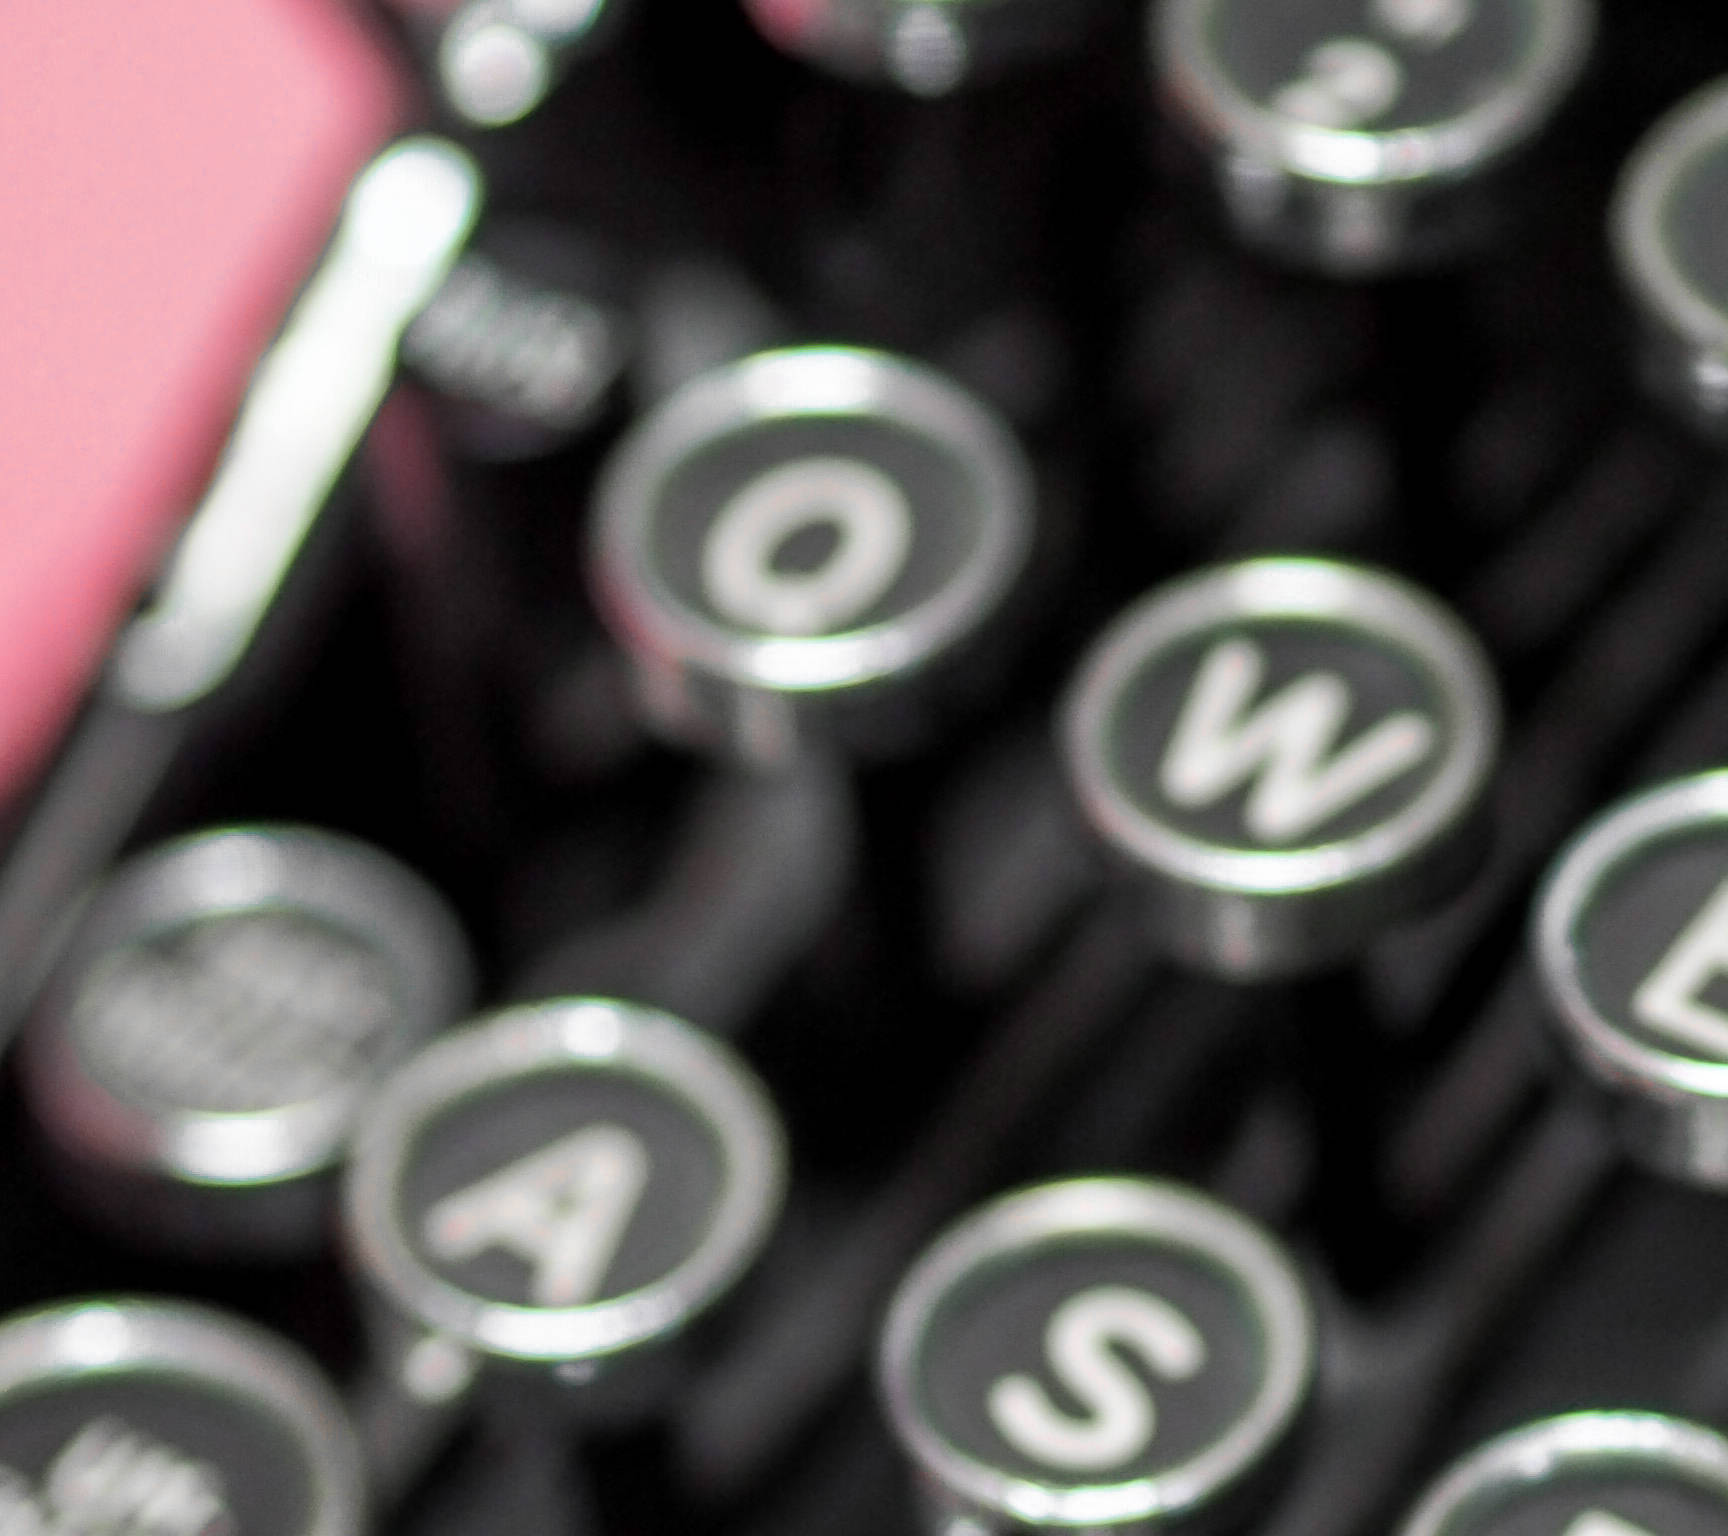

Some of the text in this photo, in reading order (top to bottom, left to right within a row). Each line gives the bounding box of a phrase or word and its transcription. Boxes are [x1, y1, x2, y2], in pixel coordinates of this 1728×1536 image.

[1160, 639, 1434, 843] W
[423, 1121, 650, 1307] A
[987, 1286, 1205, 1472] S
